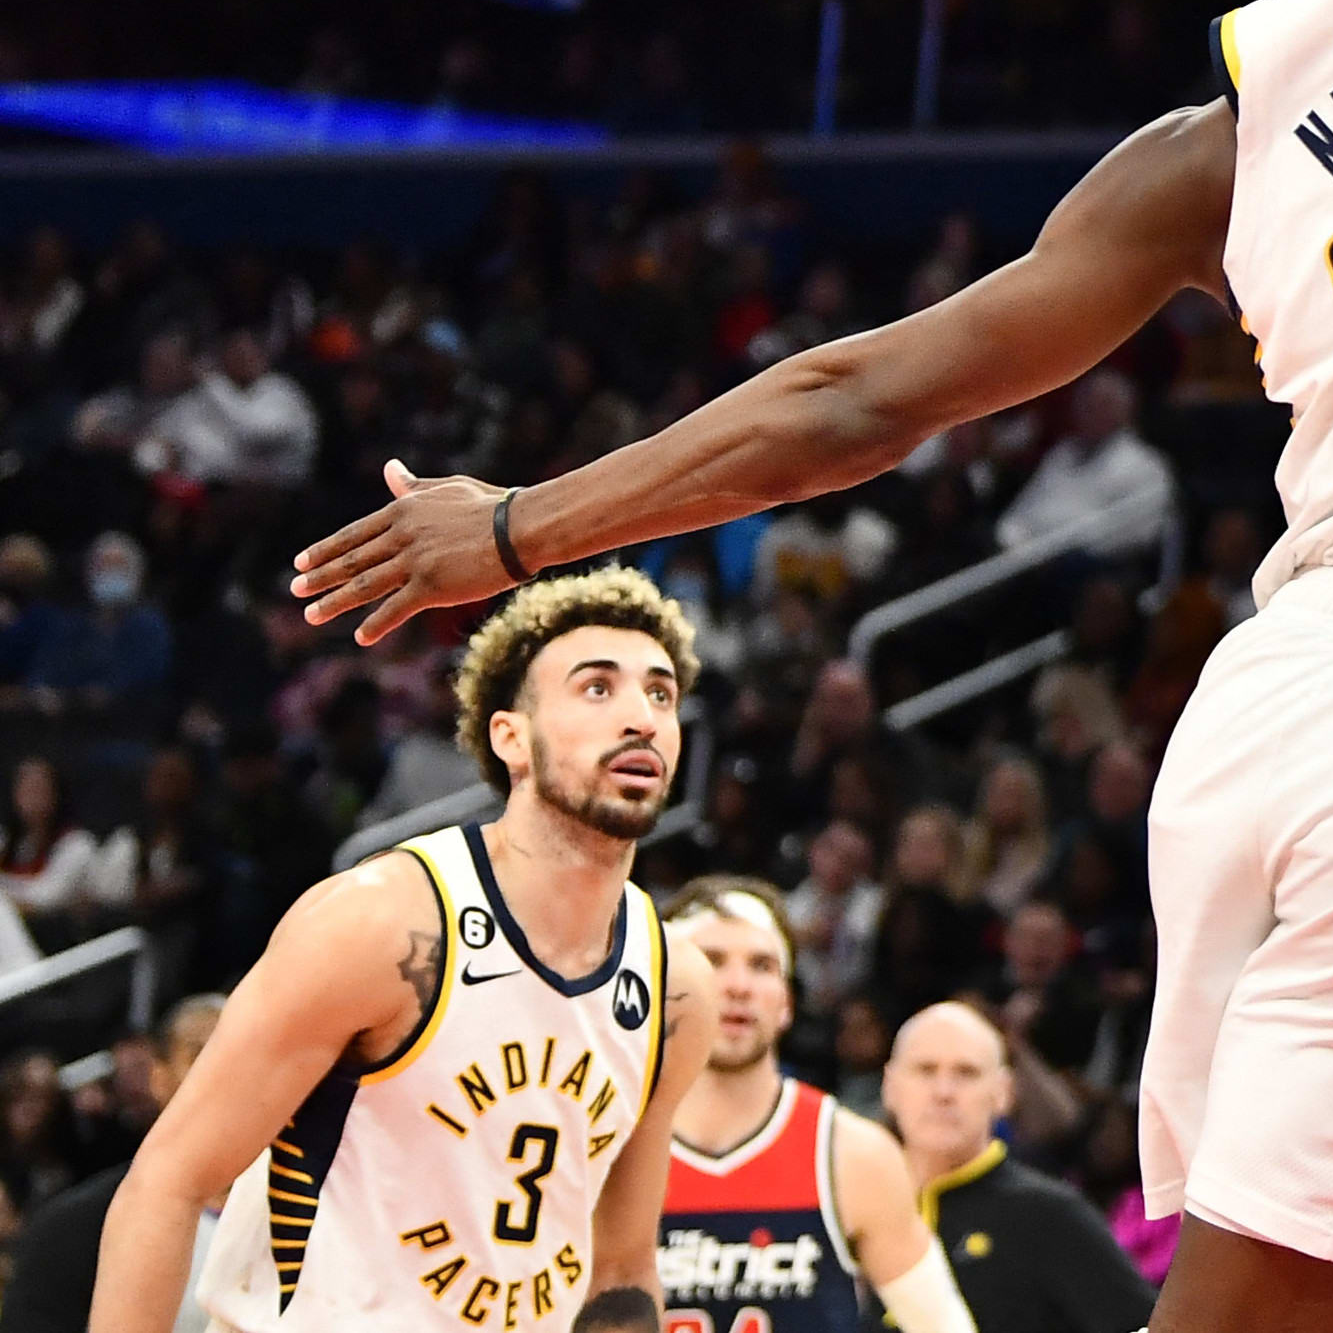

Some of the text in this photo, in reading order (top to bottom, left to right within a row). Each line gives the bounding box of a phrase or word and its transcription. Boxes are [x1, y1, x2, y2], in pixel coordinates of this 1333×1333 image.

[464, 910, 489, 946] 6
[425, 1037, 617, 1160] INDIANA
[492, 1122, 558, 1246] 3
[400, 1220, 582, 1332] PACERS
